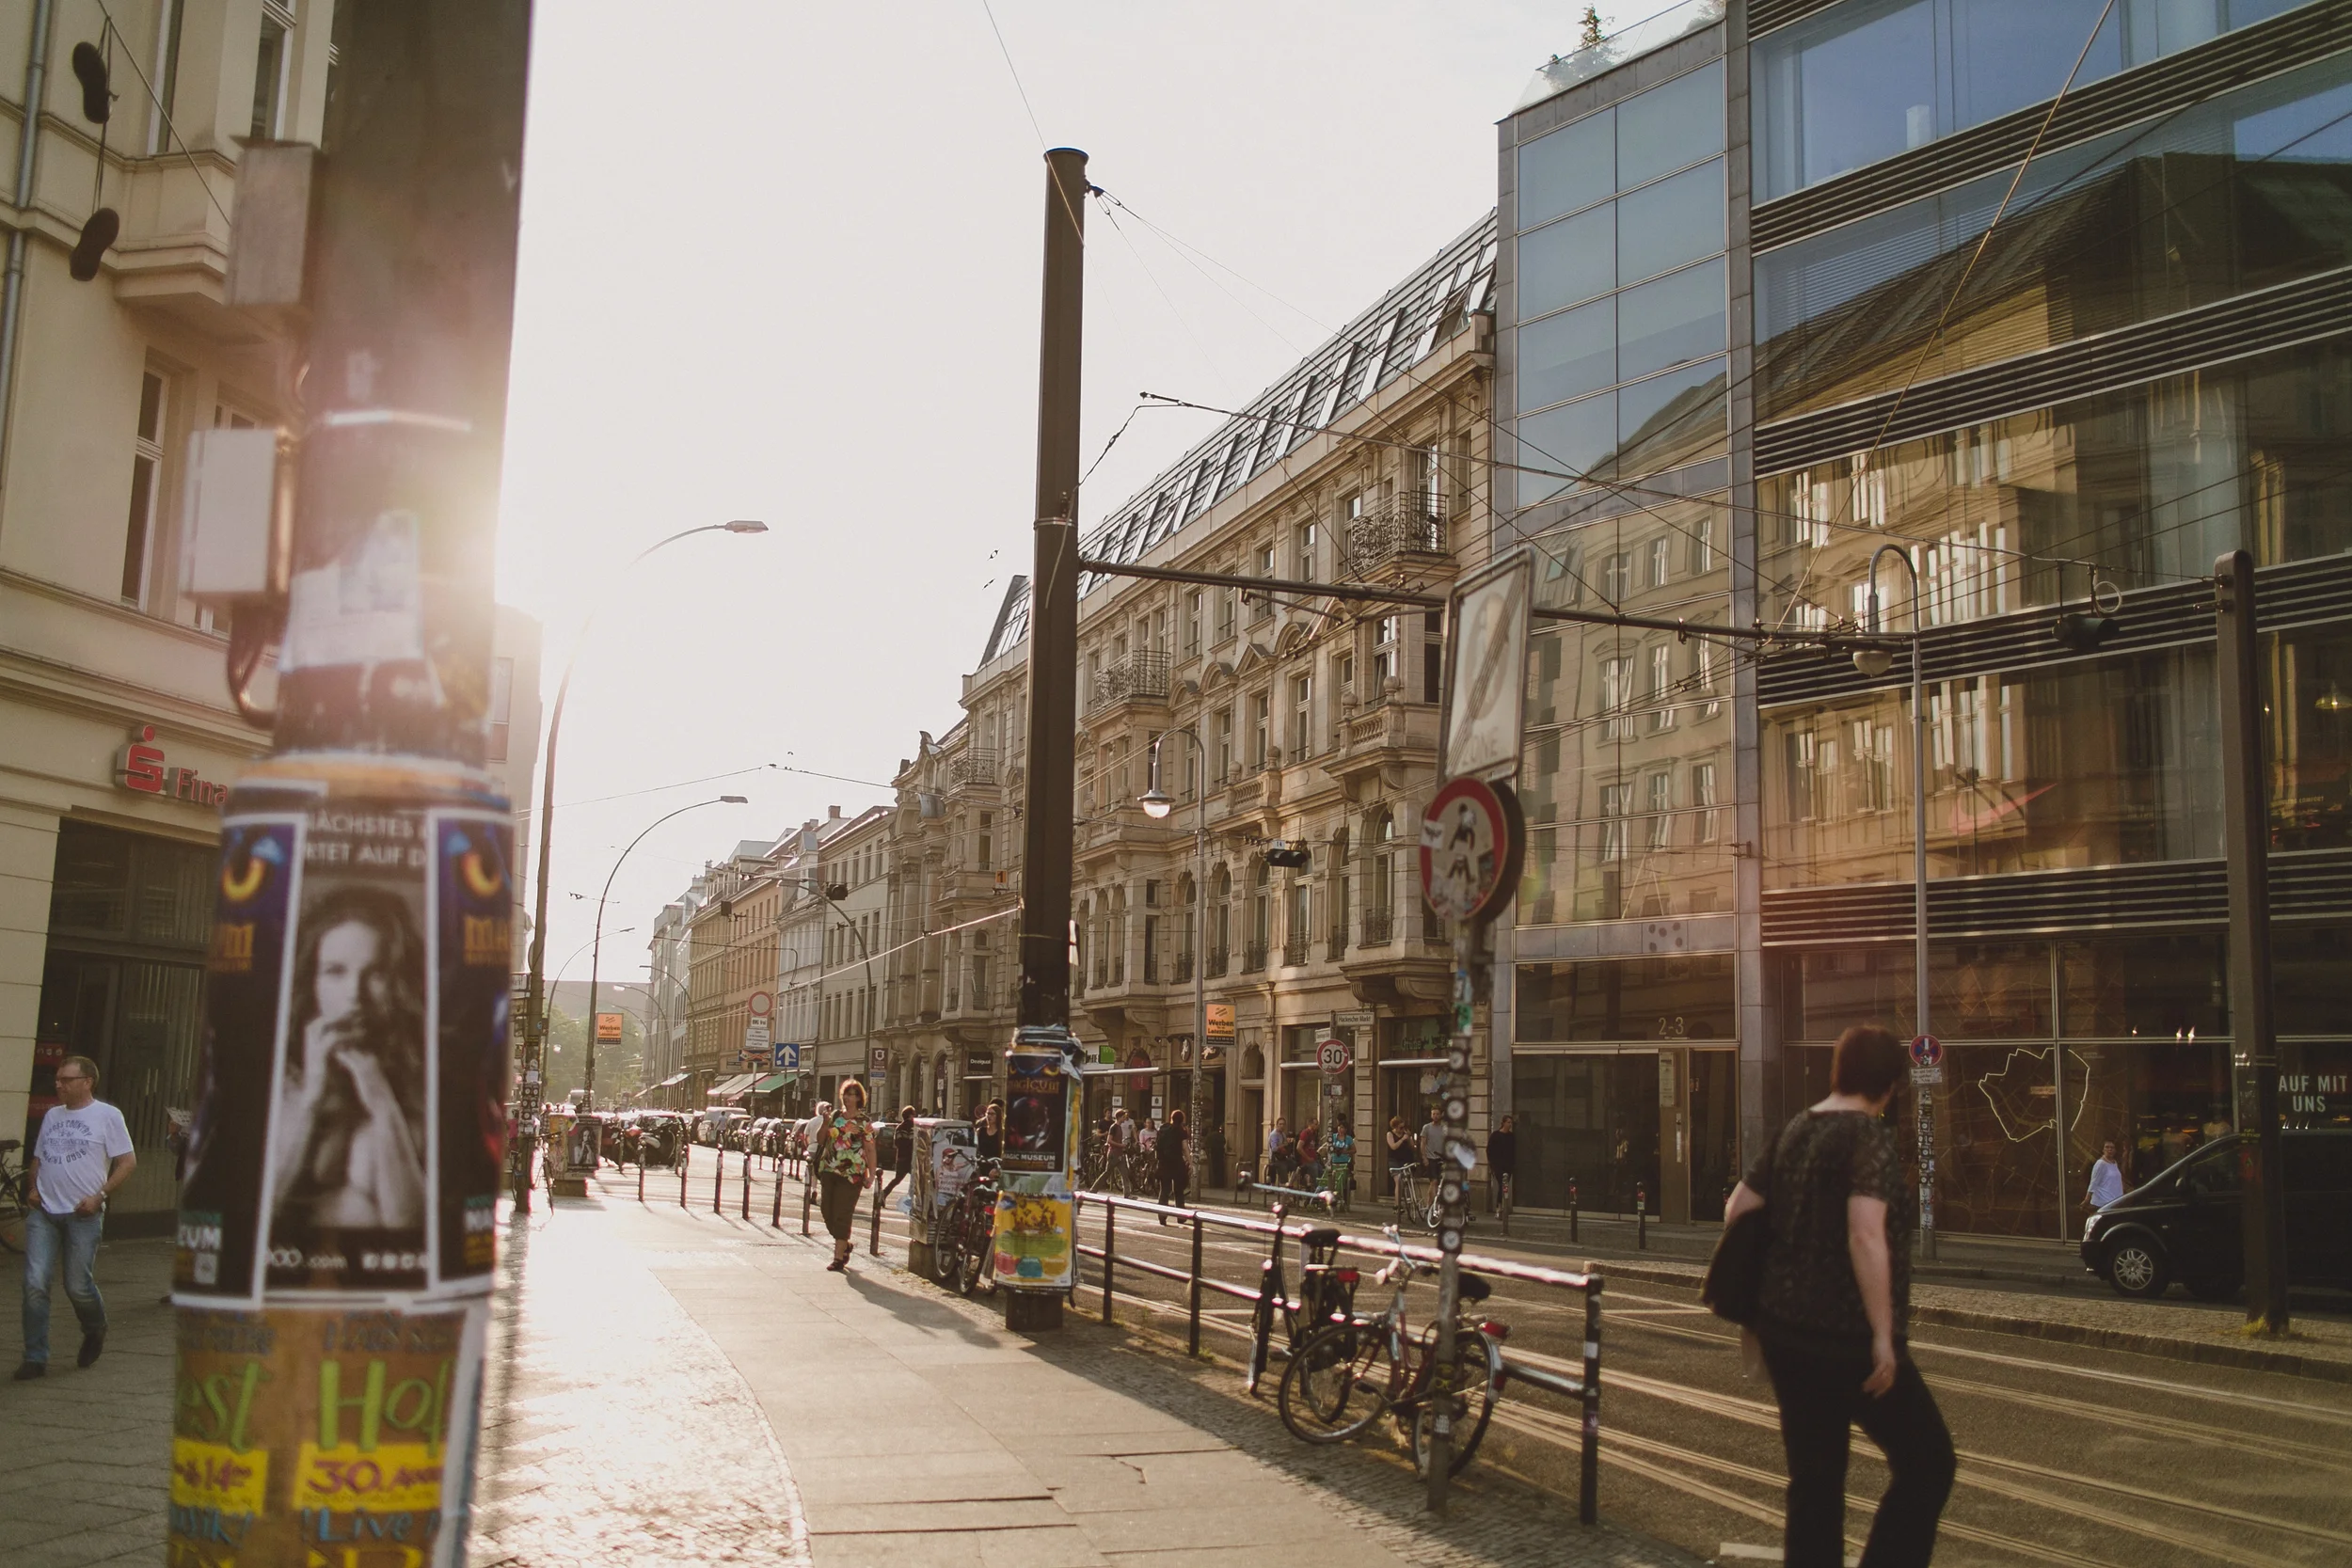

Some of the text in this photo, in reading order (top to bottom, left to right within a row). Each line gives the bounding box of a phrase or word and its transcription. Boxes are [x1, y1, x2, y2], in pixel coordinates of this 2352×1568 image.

[1658, 1016, 1684, 1035] 2-3
[1323, 1049, 1343, 1065] 30
[2278, 1074, 2347, 1092] AUF MIT
[2292, 1095, 2326, 1113] UNS
